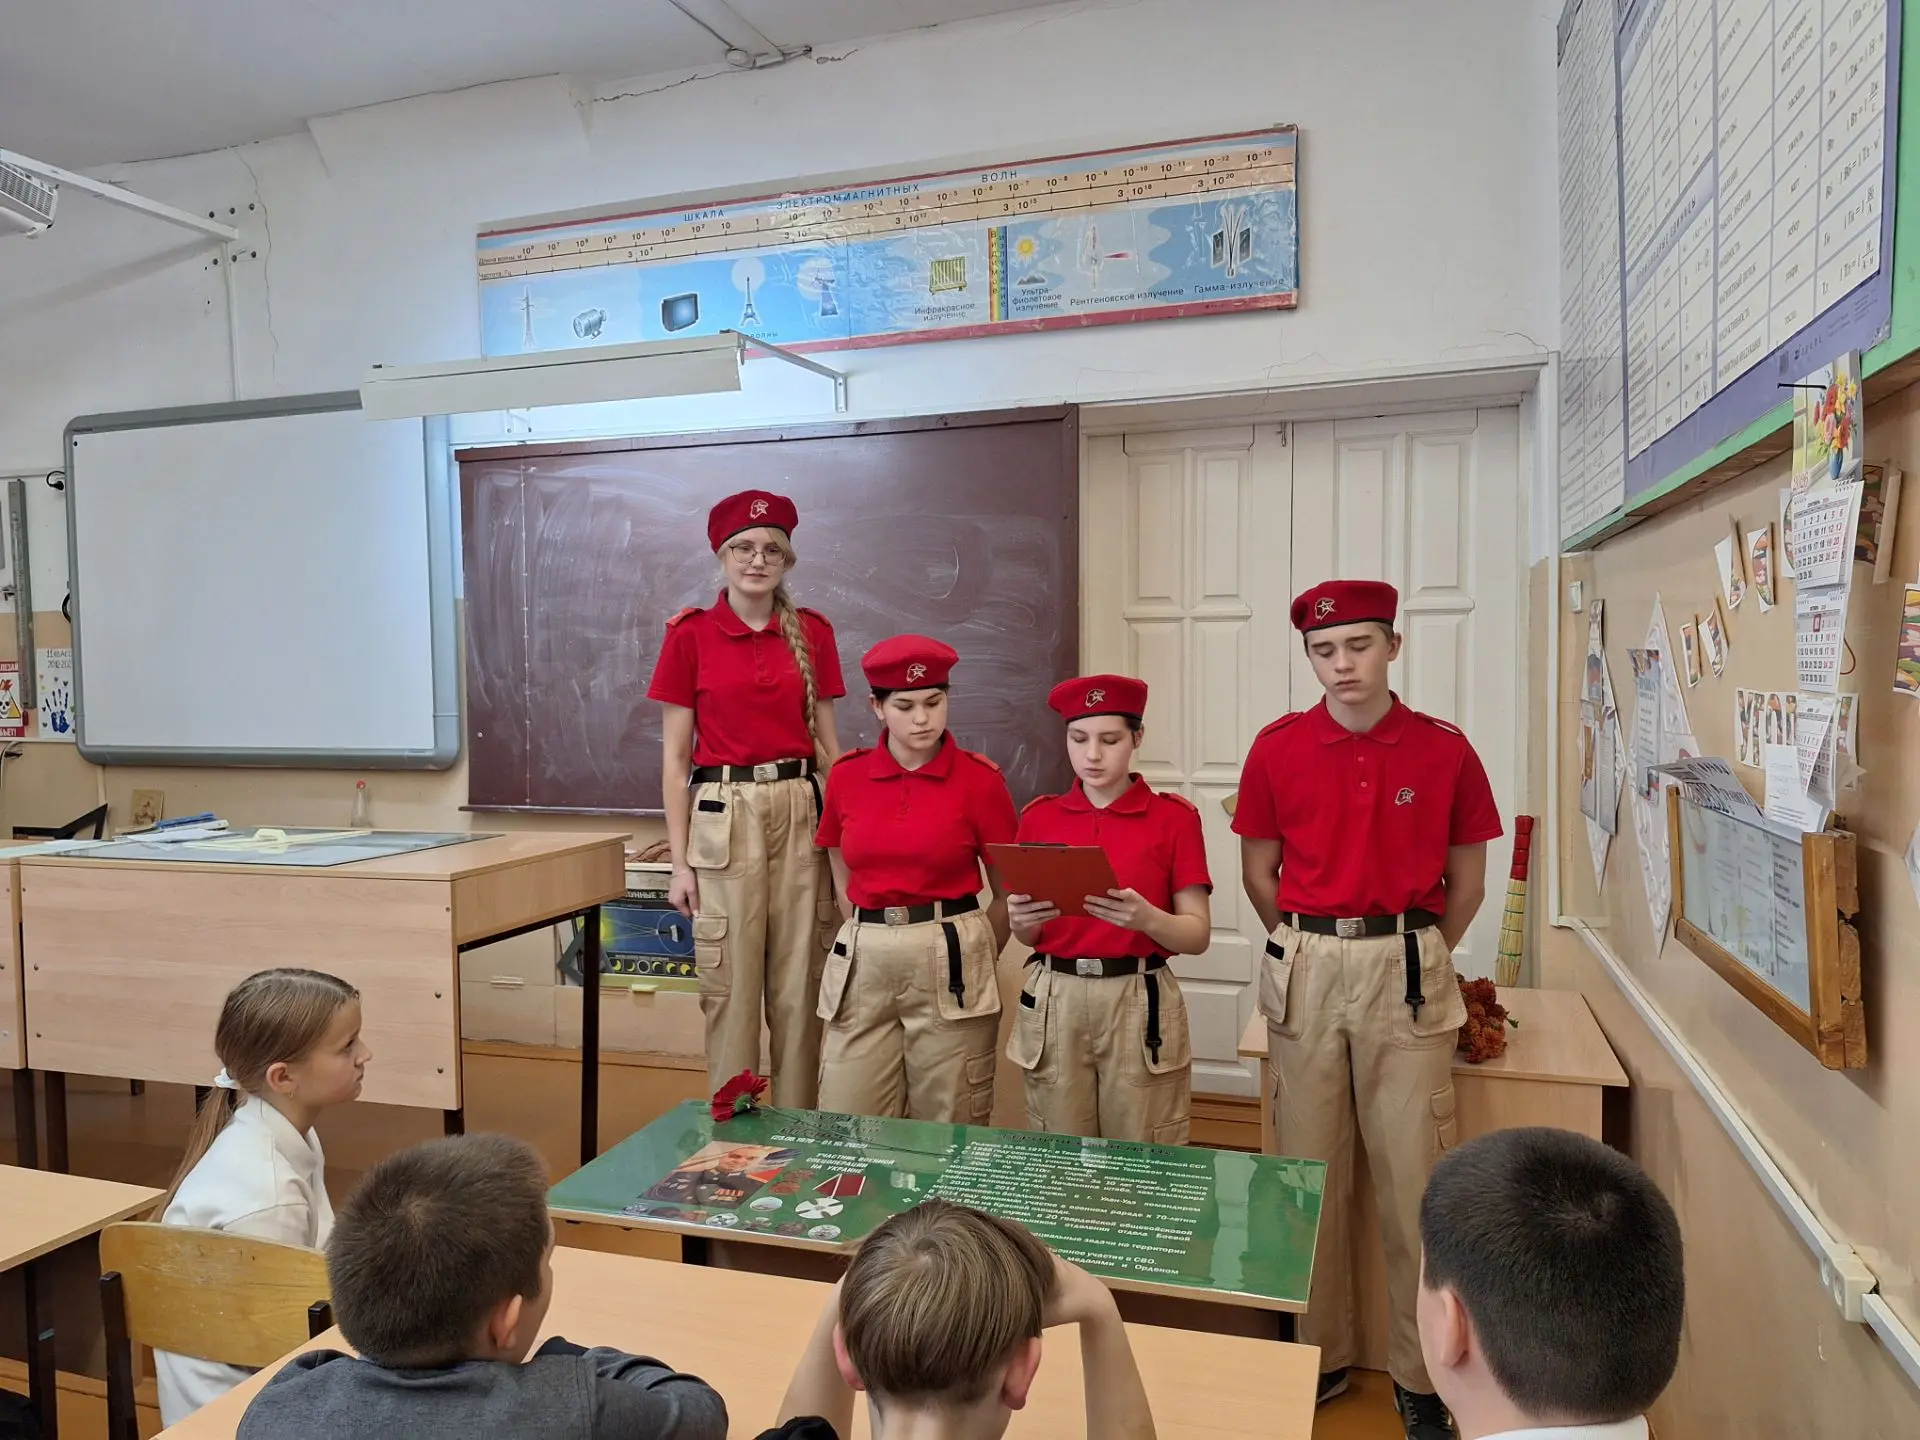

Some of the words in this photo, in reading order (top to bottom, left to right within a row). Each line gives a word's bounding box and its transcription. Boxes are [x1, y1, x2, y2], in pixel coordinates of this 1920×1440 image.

[684, 210, 725, 222] ШКАЛА
[982, 170, 1018, 183] ВОЛН
[721, 222, 731, 230] 10
[1194, 277, 1285, 295] Гамма-излучение
[1012, 294, 1062, 305] фиолетовое
[1070, 292, 1135, 306] Рентгеновское
[1137, 288, 1184, 300] излучение
[914, 302, 975, 315] Инфракрасное
[1016, 302, 1059, 312] излучение
[0, 663, 19, 671] ЛЕЗАЙ
[1119, 1223, 1192, 1235] общевойсковой
[1156, 1233, 1190, 1241] Боевой
[1132, 1244, 1186, 1254] территории
[1086, 1252, 1124, 1260] участие
[1066, 1257, 1114, 1266] медалями
[1134, 1265, 1178, 1275] Орденом
